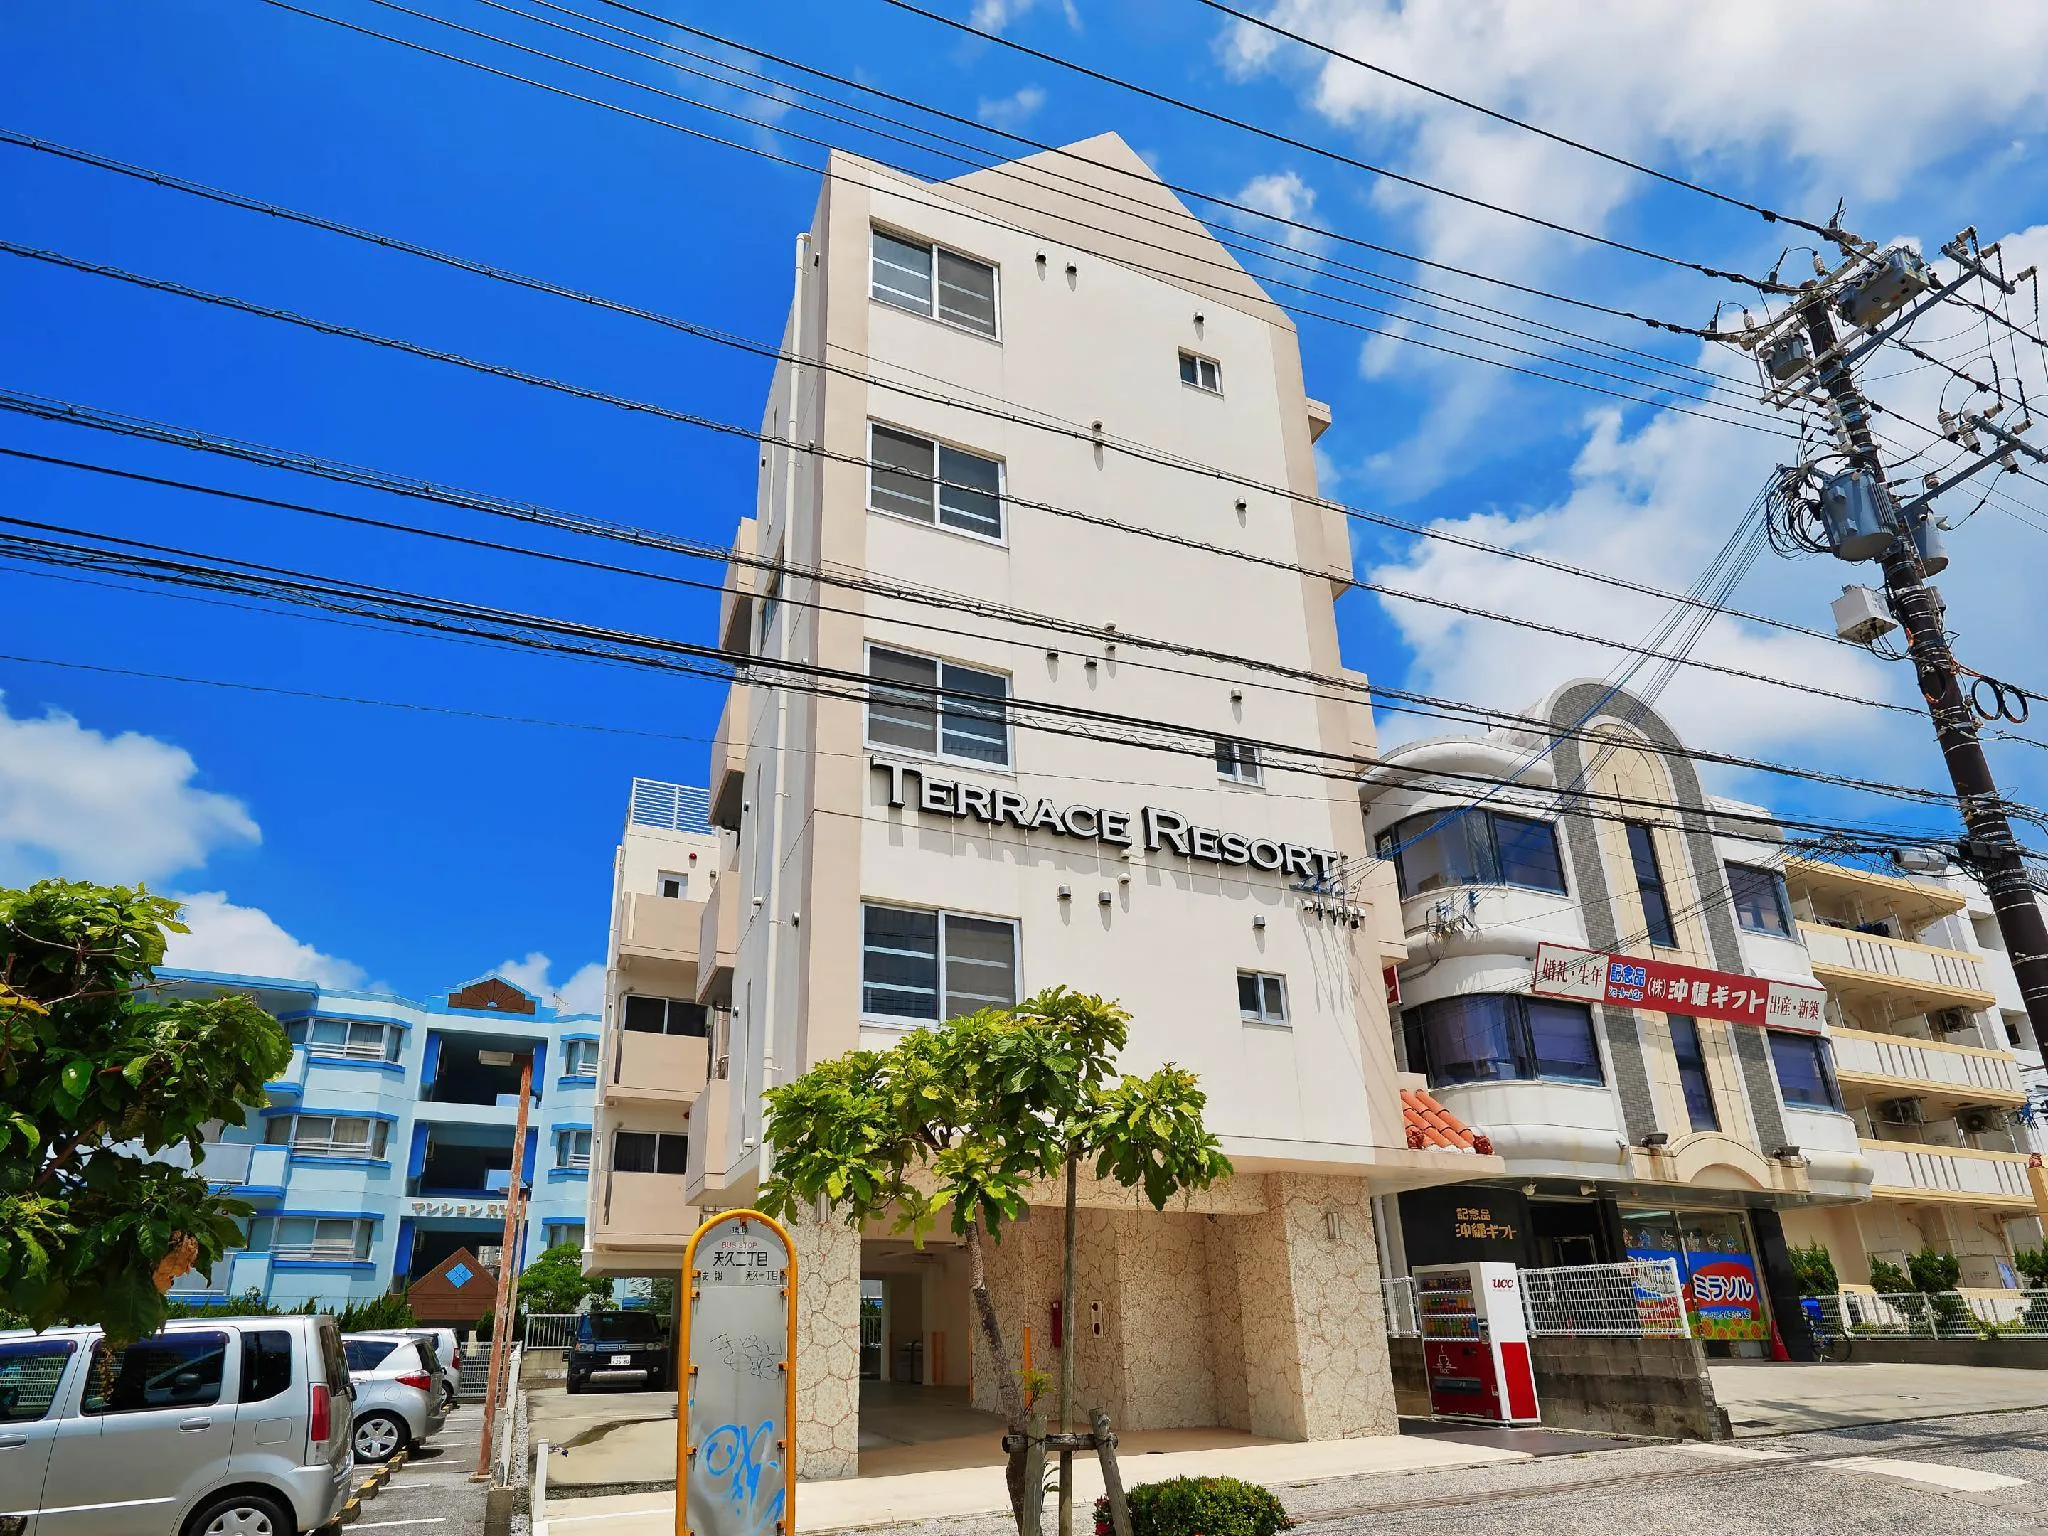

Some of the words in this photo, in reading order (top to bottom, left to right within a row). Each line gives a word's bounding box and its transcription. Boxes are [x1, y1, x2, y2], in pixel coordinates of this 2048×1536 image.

[870, 756, 1132, 845] TERRACE
[1142, 806, 1338, 880] RESORT
[1610, 963, 1646, 987] 記念品
[1769, 995, 1820, 1021] 出産・新築
[412, 1202, 483, 1217] マンション
[1456, 1207, 1491, 1220] 記念品
[1455, 1223, 1517, 1239] 沖縄ギフト
[721, 1241, 737, 1249] BUS
[739, 1241, 758, 1249] STOP
[712, 1251, 768, 1267] 天久二丁目
[1693, 1273, 1754, 1301] ミラソル
